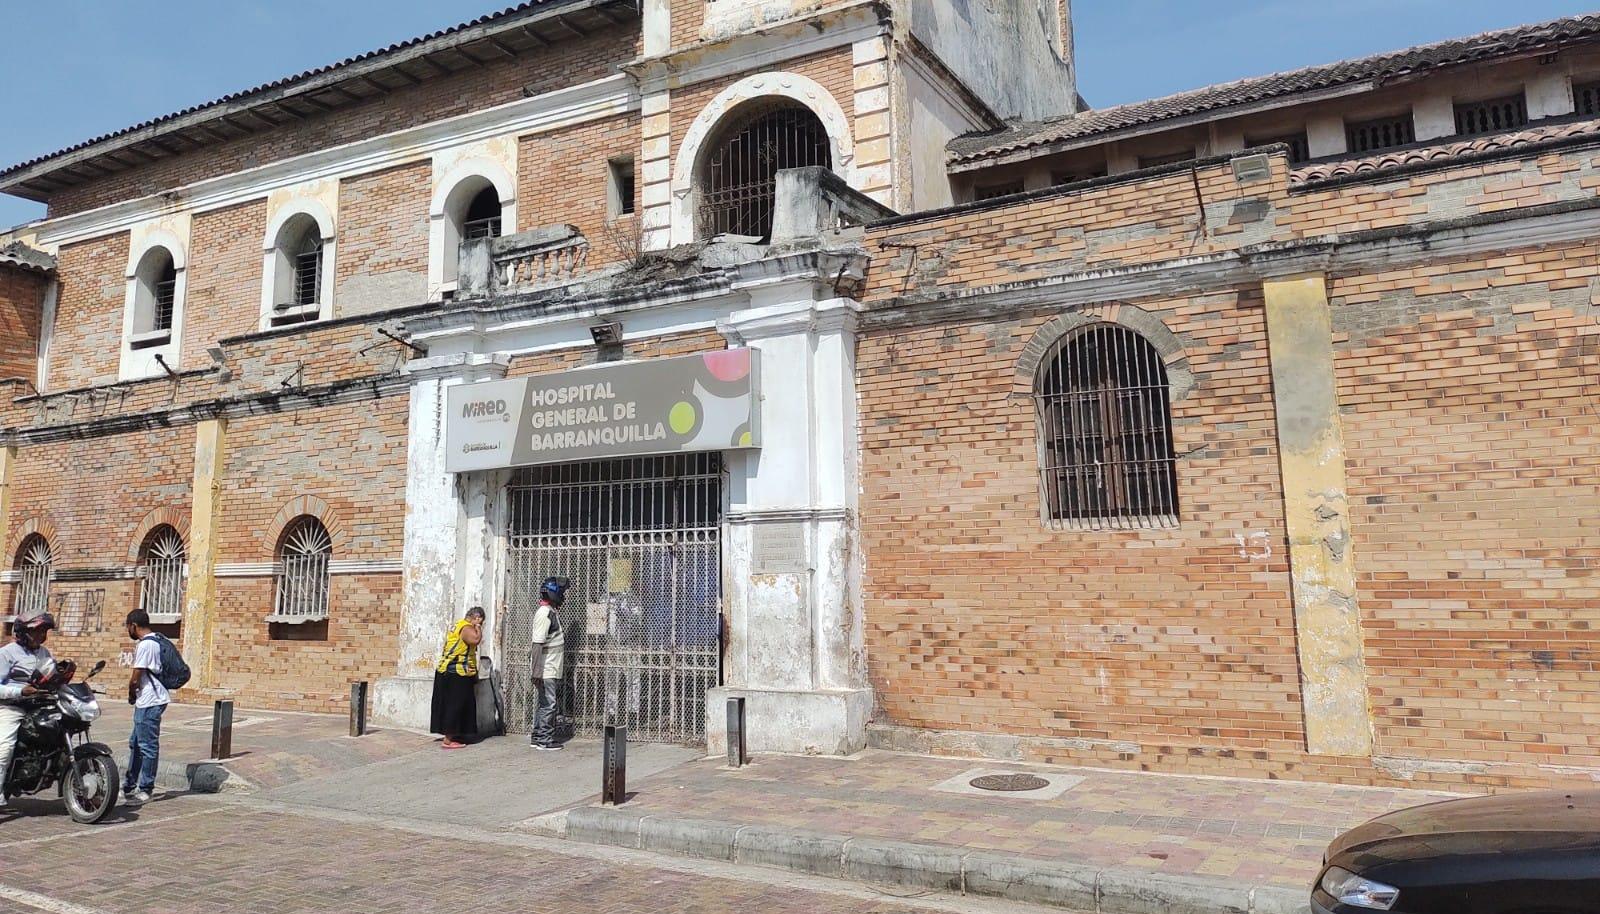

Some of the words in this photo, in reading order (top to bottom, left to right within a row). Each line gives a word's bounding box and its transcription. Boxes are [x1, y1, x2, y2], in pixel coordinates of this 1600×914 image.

[532, 382, 616, 407] HOSPITAL
[531, 404, 609, 429] GENERAL
[613, 401, 636, 421] DE
[531, 421, 667, 451] BARRANQUILLA
